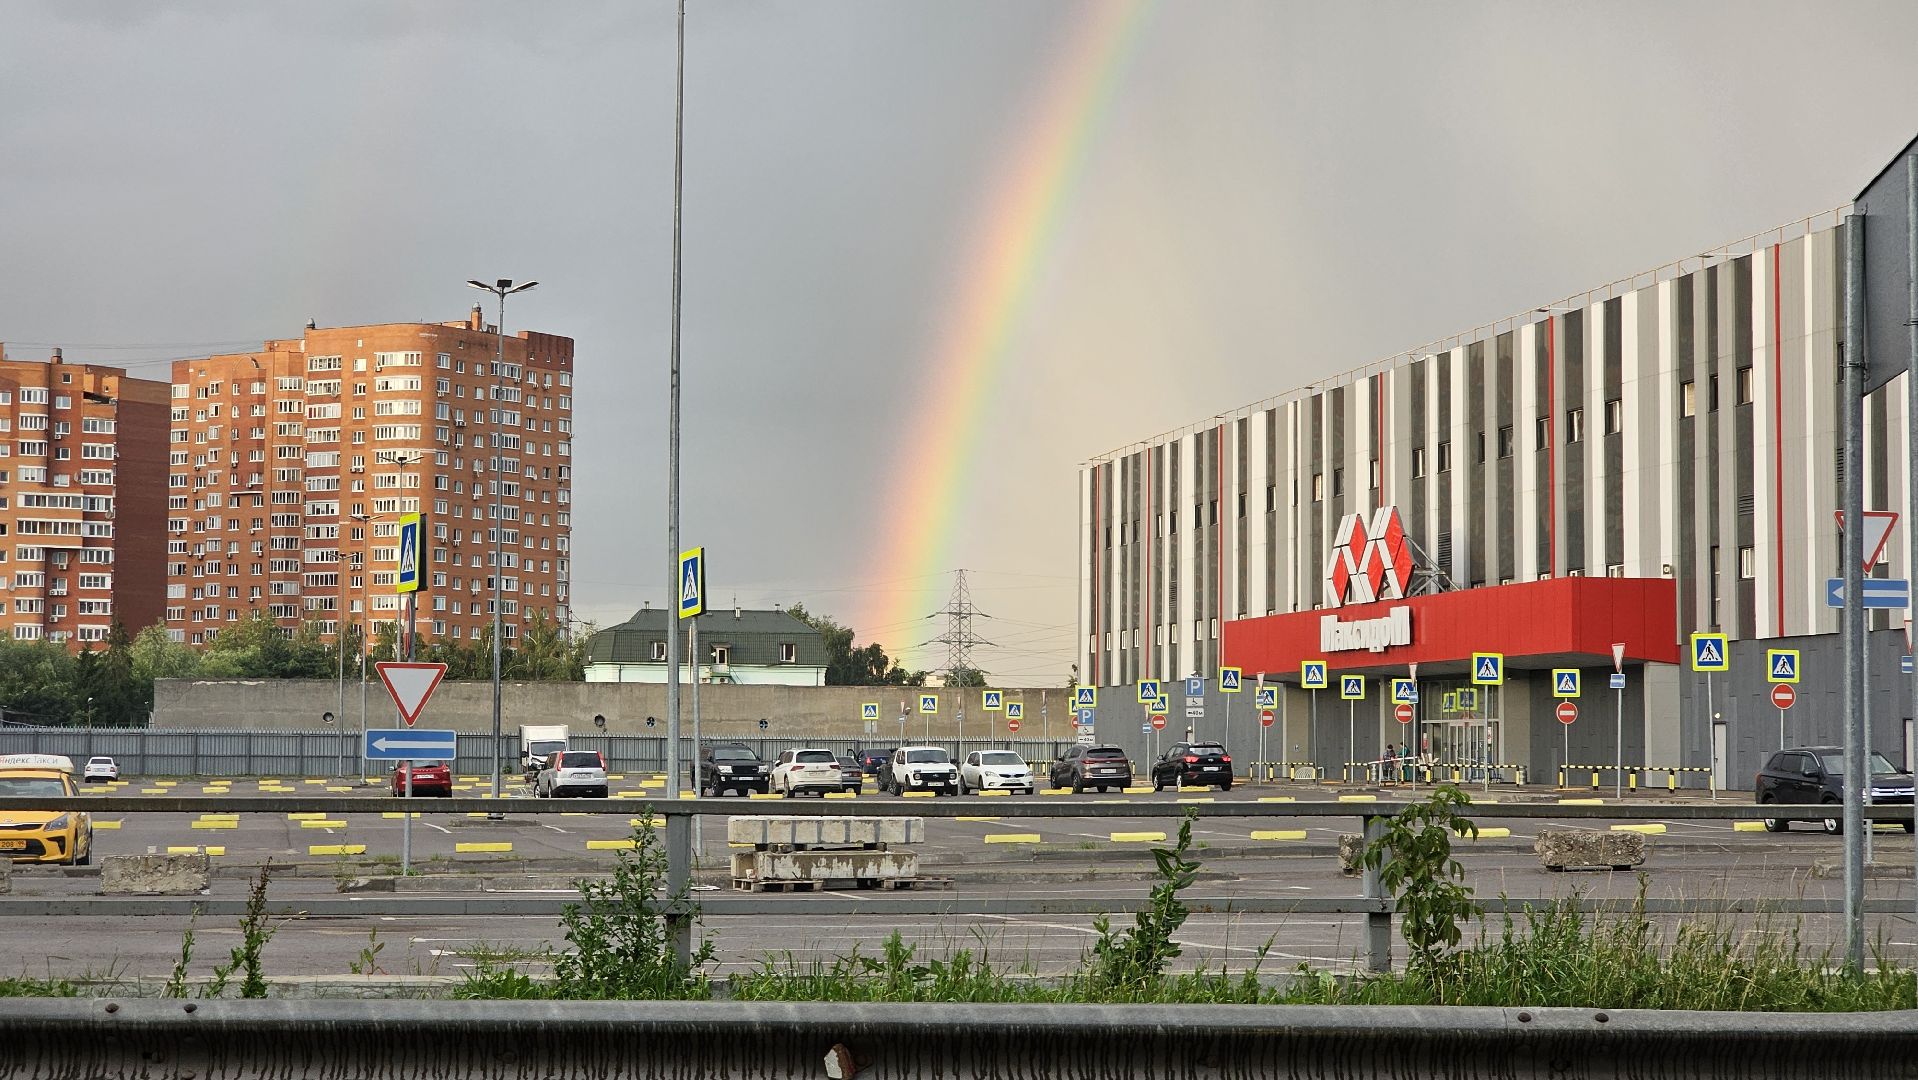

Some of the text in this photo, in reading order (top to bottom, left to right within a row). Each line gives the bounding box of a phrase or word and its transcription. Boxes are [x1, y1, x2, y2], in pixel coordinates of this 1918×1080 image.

[1190, 679, 1201, 694] P
[1082, 709, 1092, 723] P
[34, 756, 58, 765] Такси
